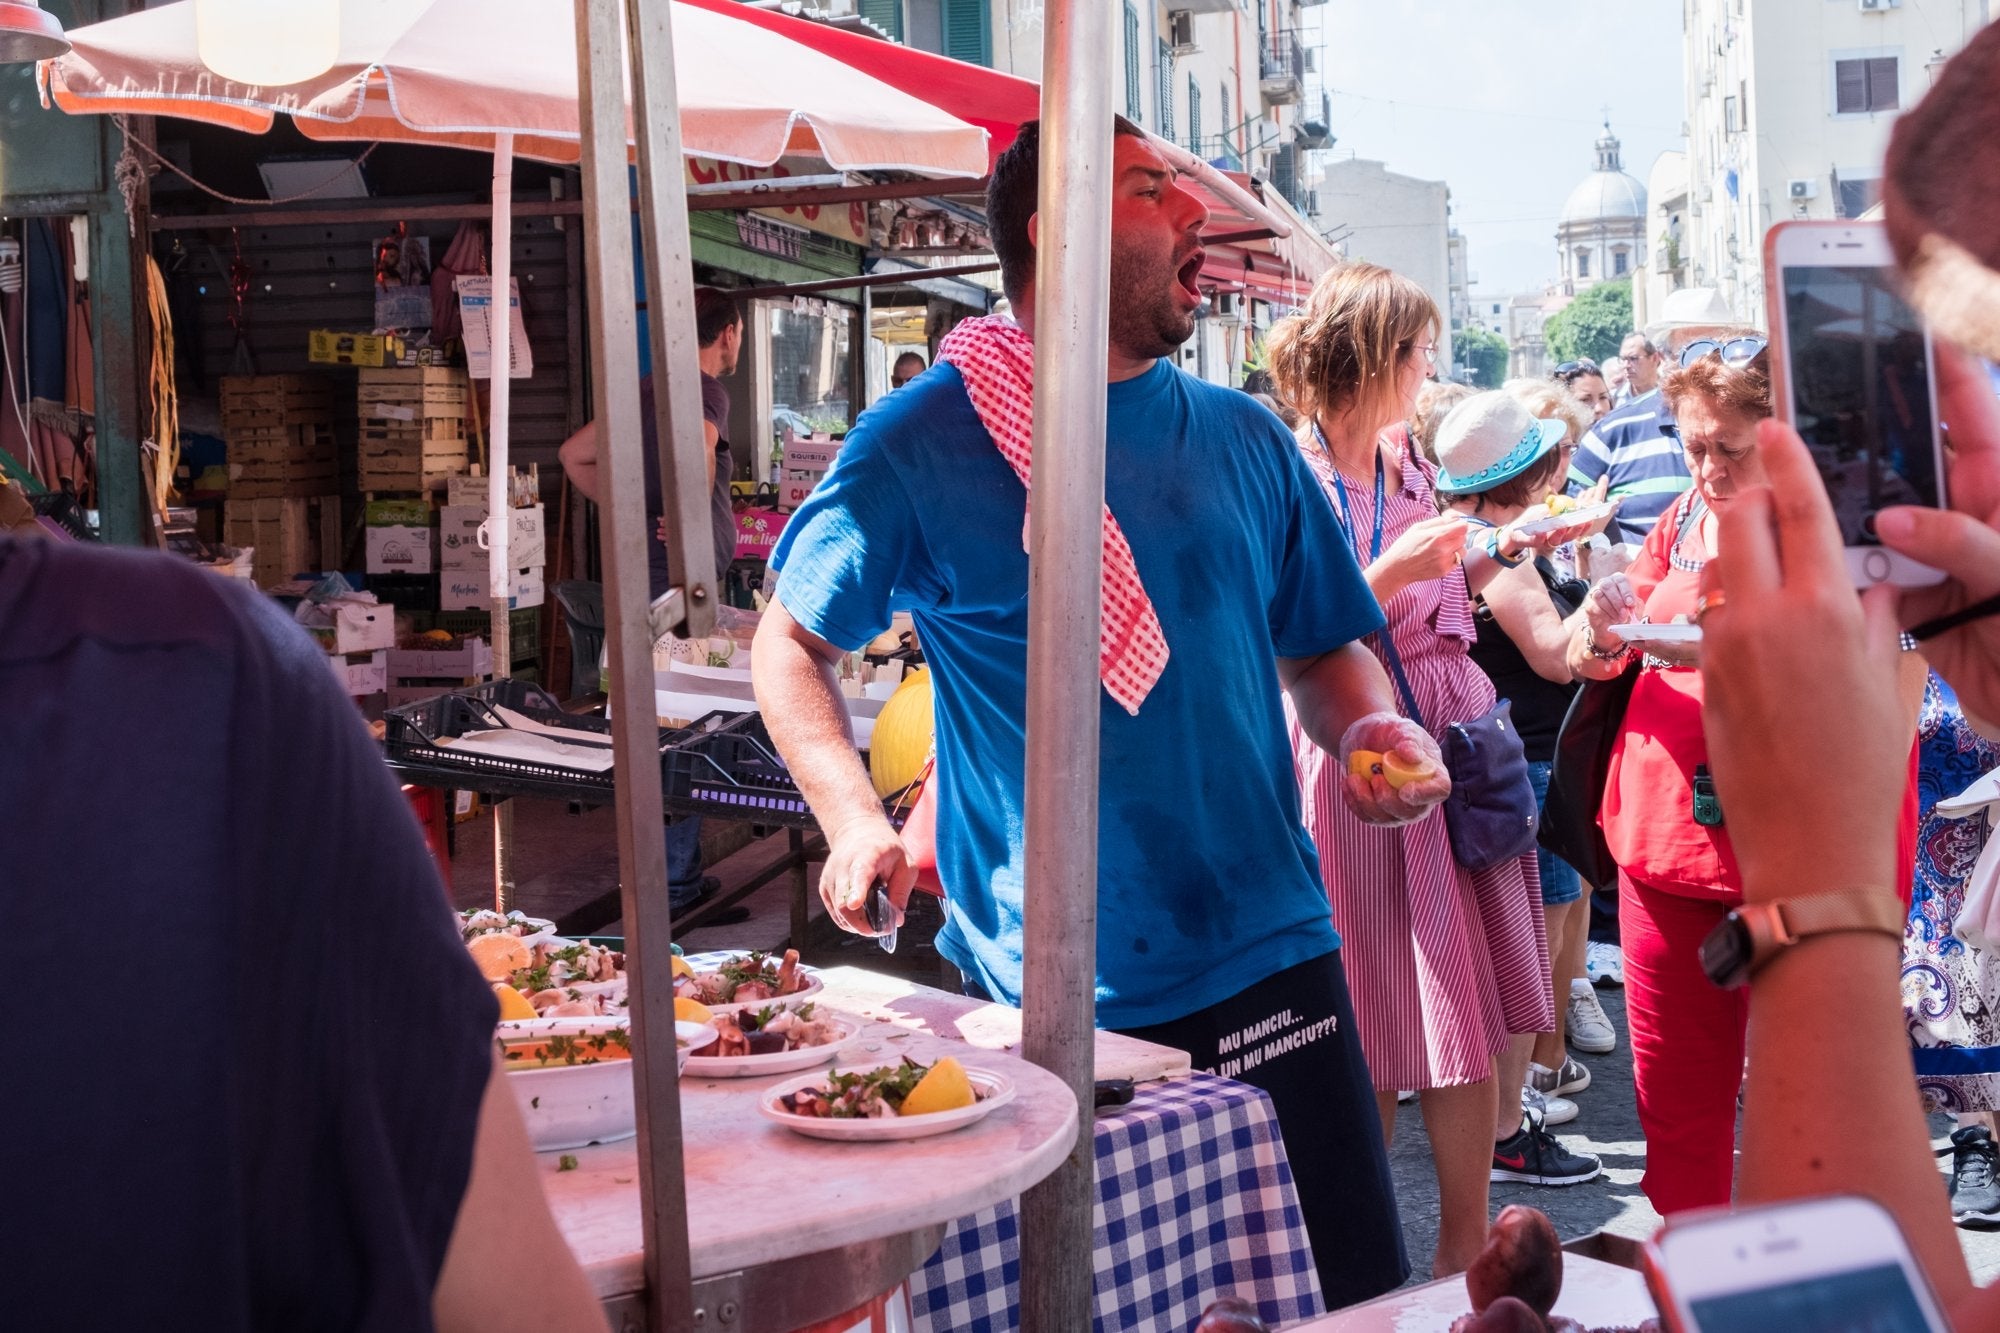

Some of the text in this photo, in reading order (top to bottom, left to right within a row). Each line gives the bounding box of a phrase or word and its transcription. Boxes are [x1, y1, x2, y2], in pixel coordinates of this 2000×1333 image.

[791, 453, 827, 461] SQUISITA
[1219, 1009, 1304, 1055] MU MANCIU...
[1220, 1058, 1241, 1078] UN
[1244, 1048, 1262, 1071] MU
[1264, 1015, 1337, 1061] MANCIU???
